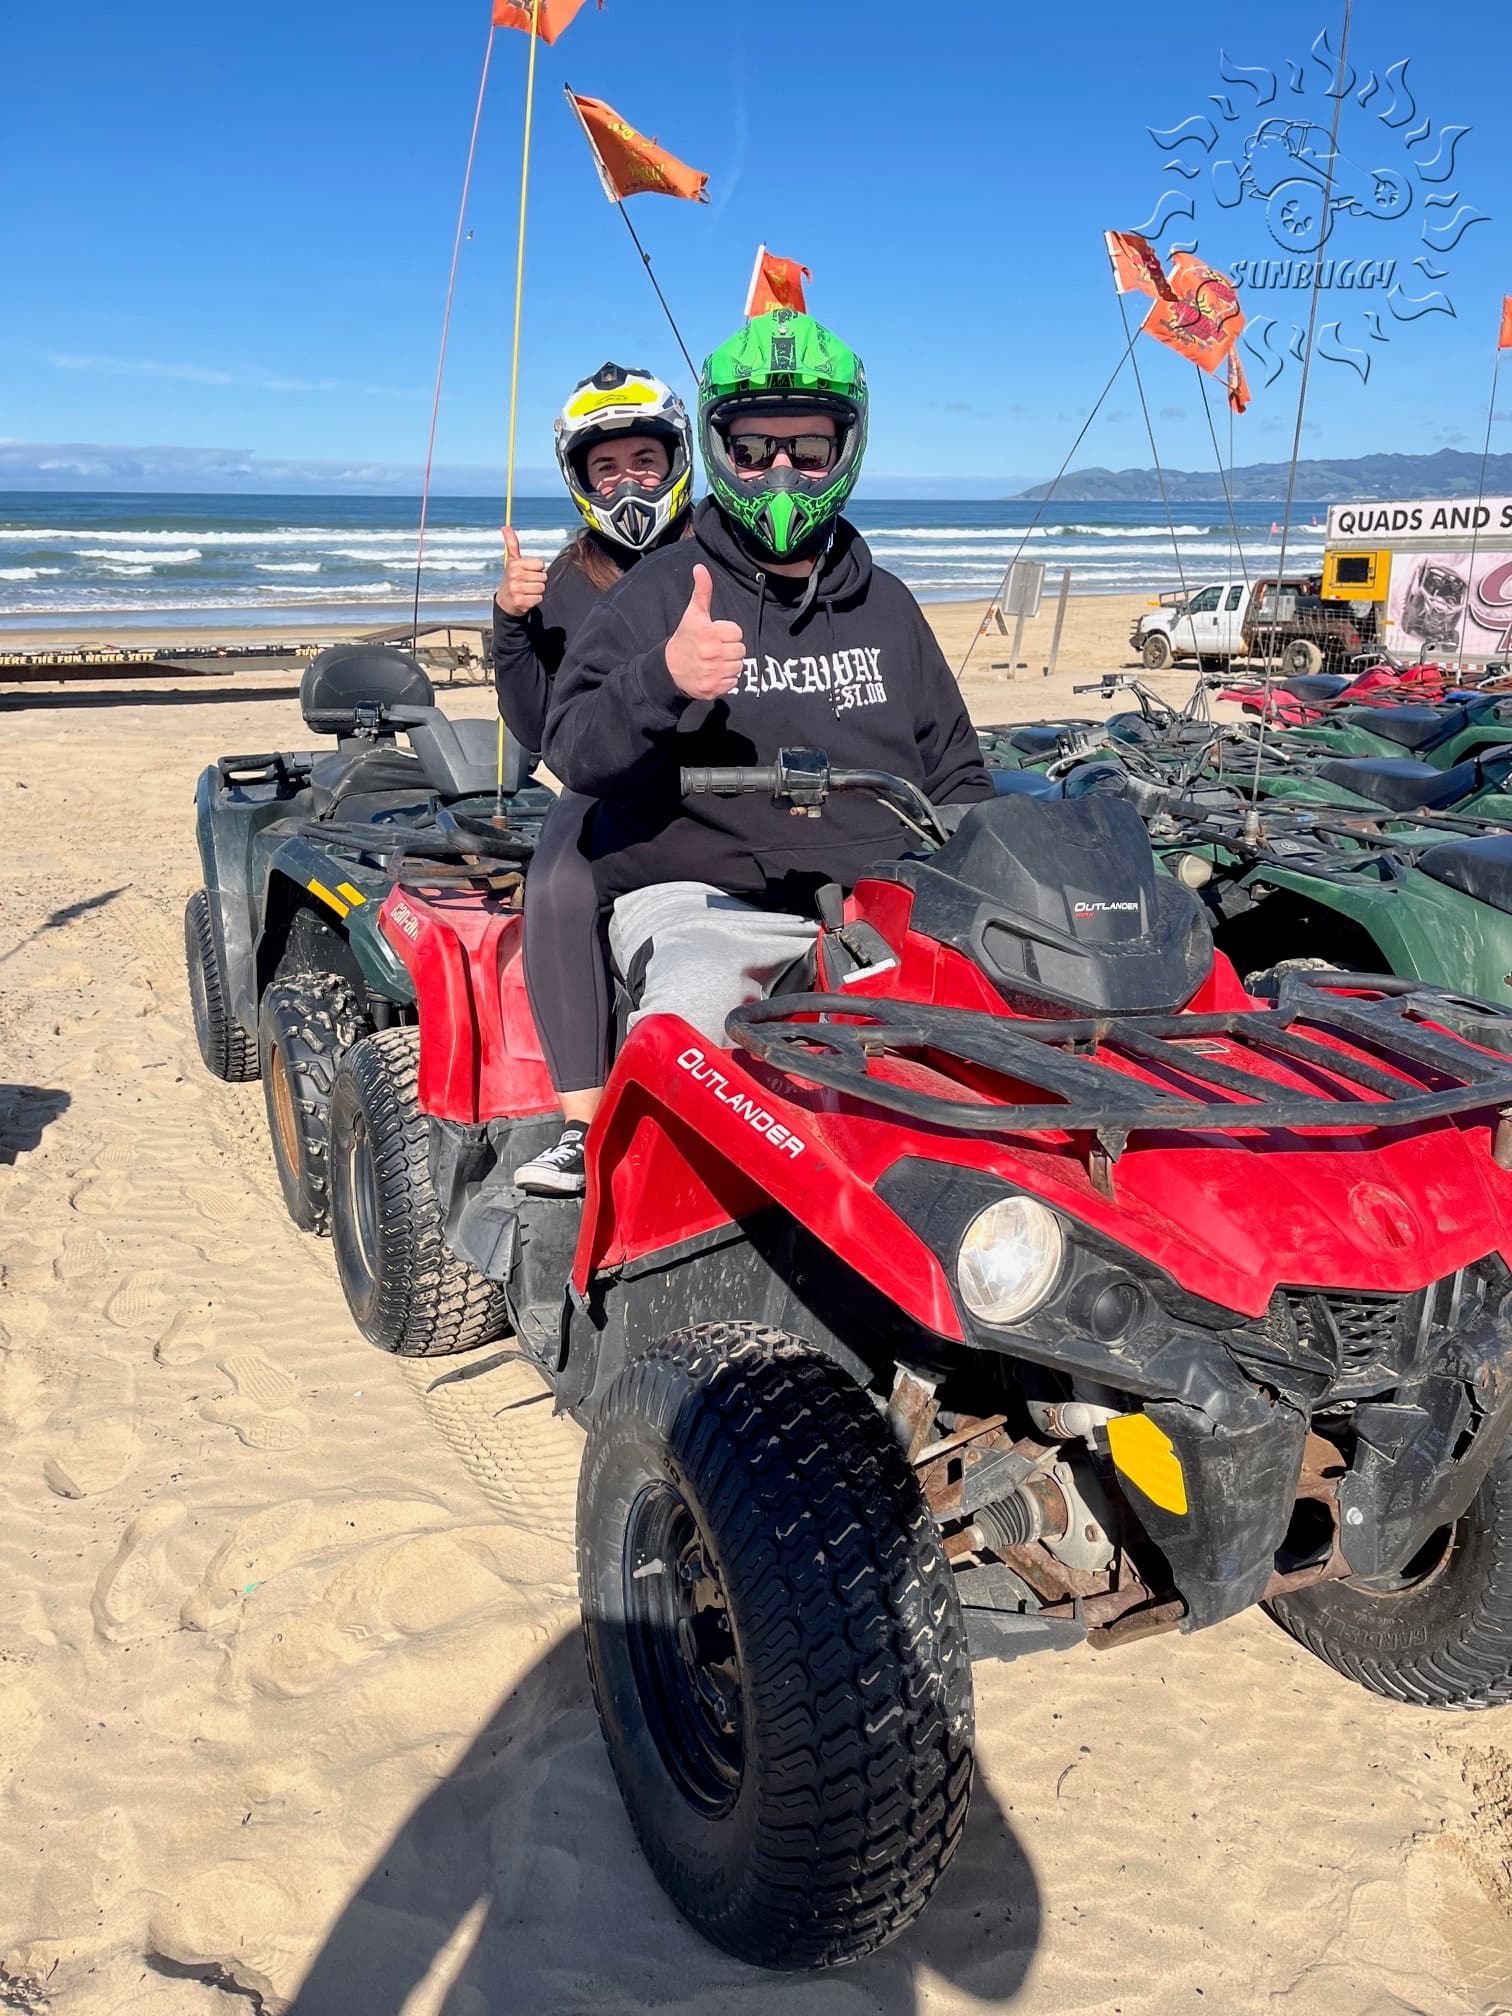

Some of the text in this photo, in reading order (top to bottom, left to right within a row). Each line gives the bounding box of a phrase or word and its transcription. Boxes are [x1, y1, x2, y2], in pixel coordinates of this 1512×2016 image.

[1338, 508, 1423, 534] QUADS
[1430, 506, 1490, 529] AND
[31, 654, 54, 665] THE
[57, 654, 82, 664] FUN
[86, 653, 124, 663] NEVER
[127, 652, 156, 662] SETS
[728, 646, 883, 698] ADEAWAY
[1074, 902, 1138, 912] OUTLANDER
[676, 1047, 806, 1160] OUTLANDER
